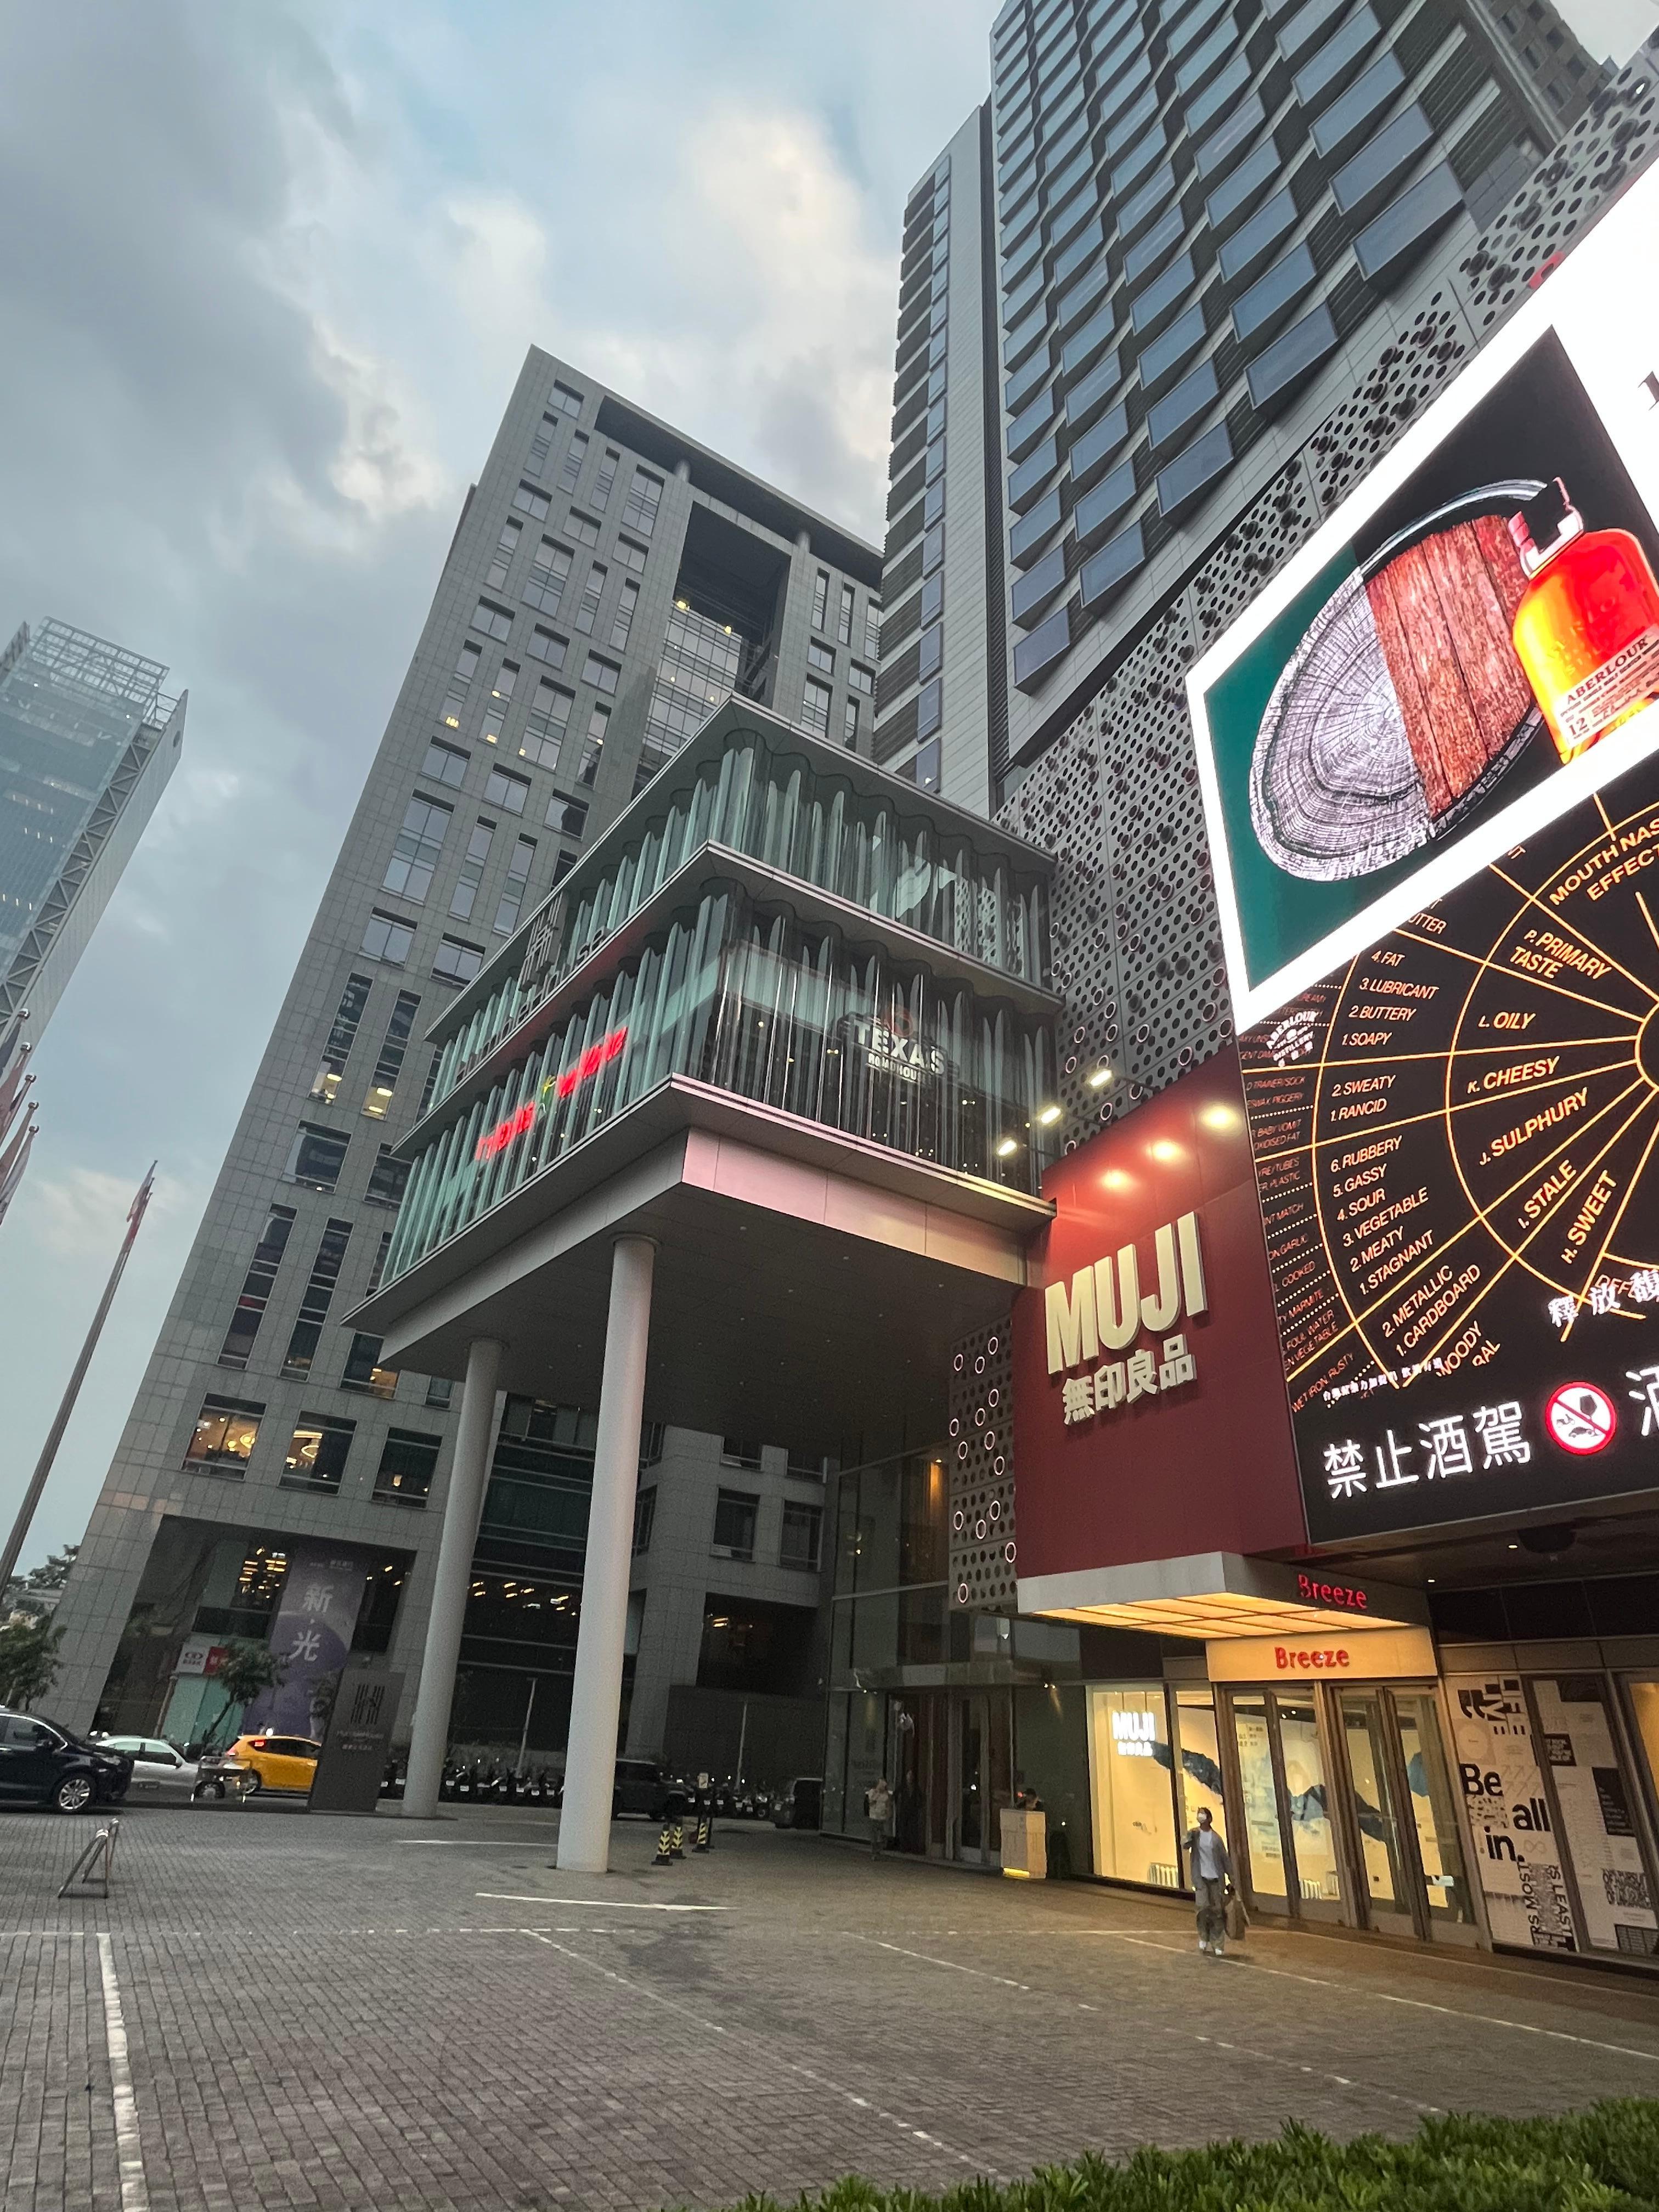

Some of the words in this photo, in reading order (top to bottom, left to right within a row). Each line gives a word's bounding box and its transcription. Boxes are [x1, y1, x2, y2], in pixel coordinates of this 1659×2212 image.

[1566, 634, 1649, 705] ABERLOUR
[1568, 717, 1588, 736] 12
[1549, 844, 1620, 905] MOUTH
[1408, 912, 1447, 934] UTTER
[1510, 945, 1564, 979] TASTE
[1535, 932, 1612, 979] PRIMARY
[1478, 1015, 1490, 1028] L.
[1493, 1012, 1536, 1029] OILY
[854, 1019, 945, 1075] TEXAS
[1483, 1056, 1560, 1090] CHEESY
[1339, 1098, 1387, 1120] RANCID
[1479, 1152, 1491, 1166] J.
[1491, 1086, 1588, 1157] SULPHURY
[1342, 1135, 1403, 1169] RUBBERY
[1345, 1163, 1387, 1192] GASSY
[1523, 1159, 1577, 1219] STALE
[1348, 1188, 1386, 1216] SOUR
[1354, 1186, 1429, 1239] VEGETABLE
[1567, 1169, 1617, 1245] SWEET
[1361, 1225, 1403, 1265] MEATY
[1367, 1229, 1433, 1289] STAGNANT
[1045, 1211, 1208, 1375] MUJI
[1392, 1265, 1453, 1327] METALLIC
[1403, 1264, 1481, 1348] CARDBOARD
[1062, 1333, 1197, 1426] 無印良品
[1323, 1400, 1532, 1499] 禁止酒駕
[1298, 1573, 1368, 1610] Breeze
[1274, 1646, 1350, 1669] Breeze
[1112, 1710, 1155, 1741] MUJI
[1459, 1763, 1504, 1796] Be
[1513, 1798, 1551, 1832] all
